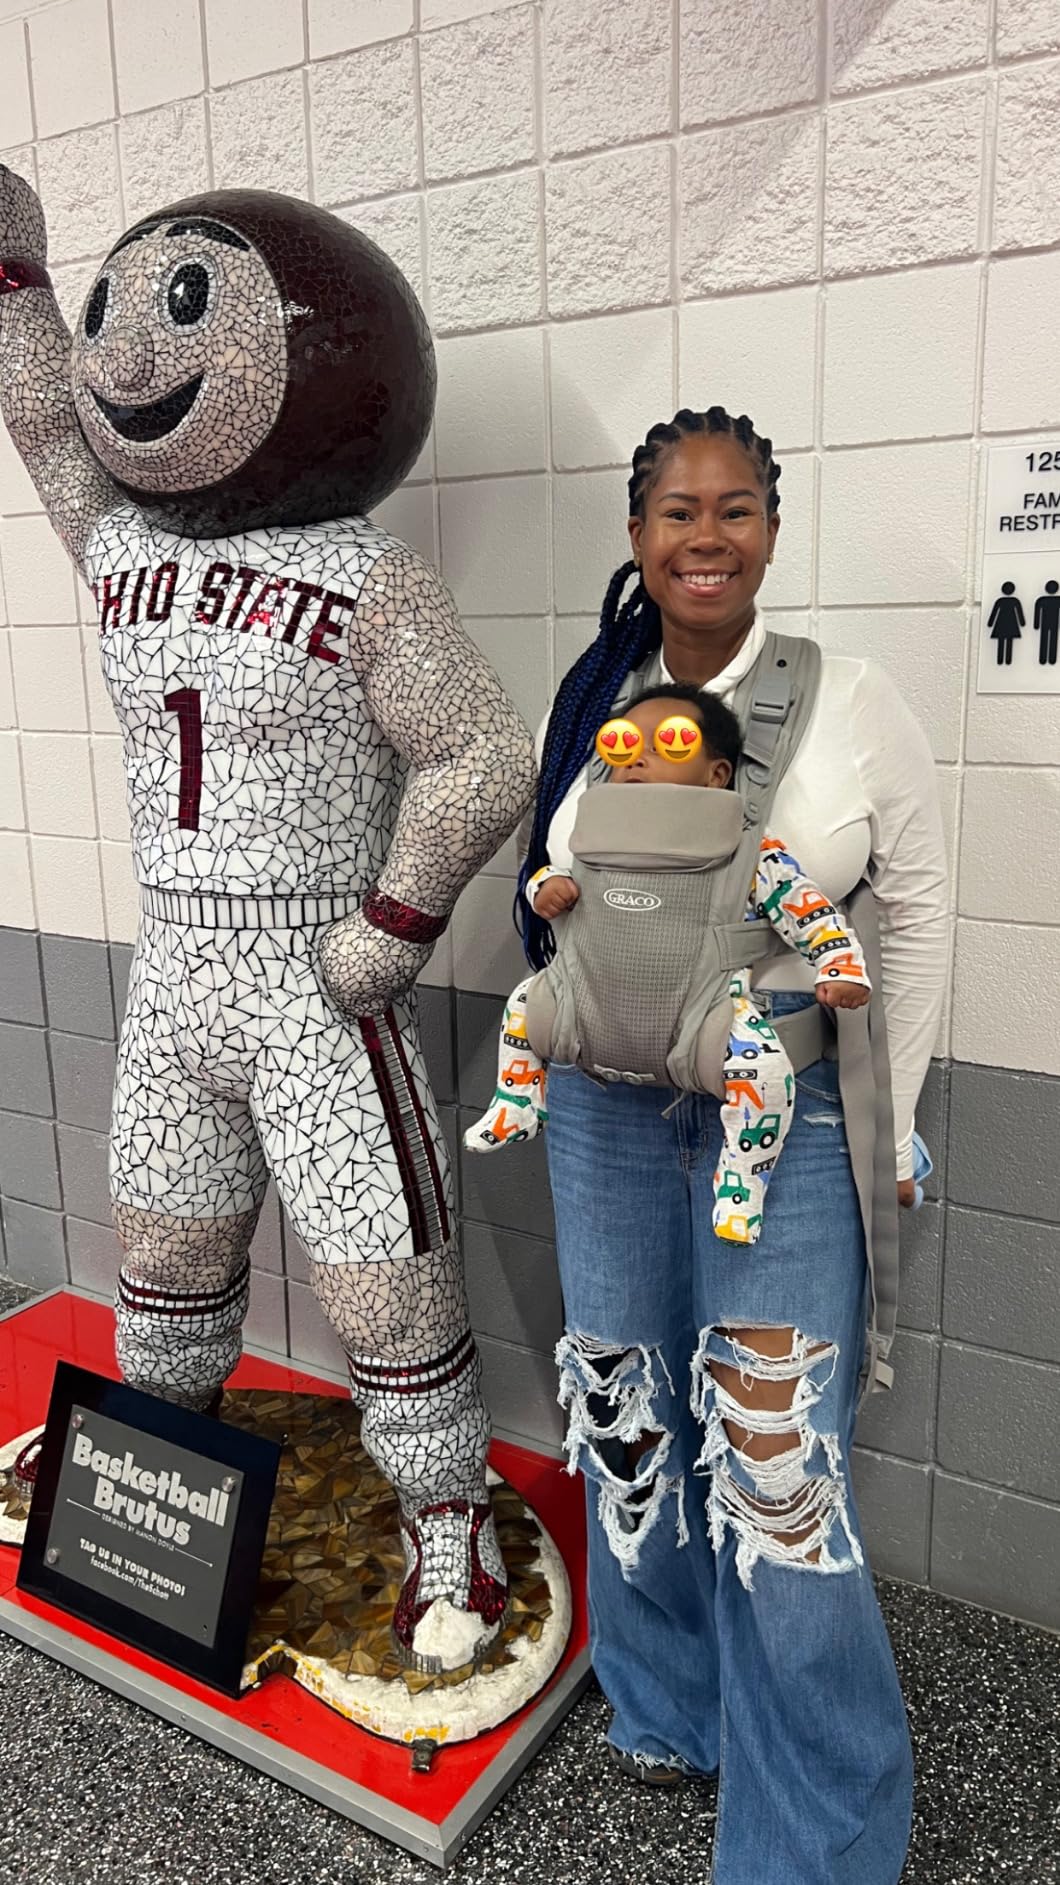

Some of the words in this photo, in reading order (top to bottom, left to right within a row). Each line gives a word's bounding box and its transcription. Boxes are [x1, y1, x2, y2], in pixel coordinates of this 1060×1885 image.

[93, 561, 180, 637] HIO
[195, 562, 357, 664] STATE
[163, 688, 202, 831] 1
[608, 892, 655, 907] GRACO
[72, 1432, 230, 1527] Basketball
[93, 1475, 192, 1546] Brutus
[80, 1538, 97, 1553] TAG
[98, 1546, 110, 1560] US
[112, 1553, 122, 1566] IN
[124, 1559, 149, 1579] YOUR
[151, 1571, 186, 1597] PHOTO!
